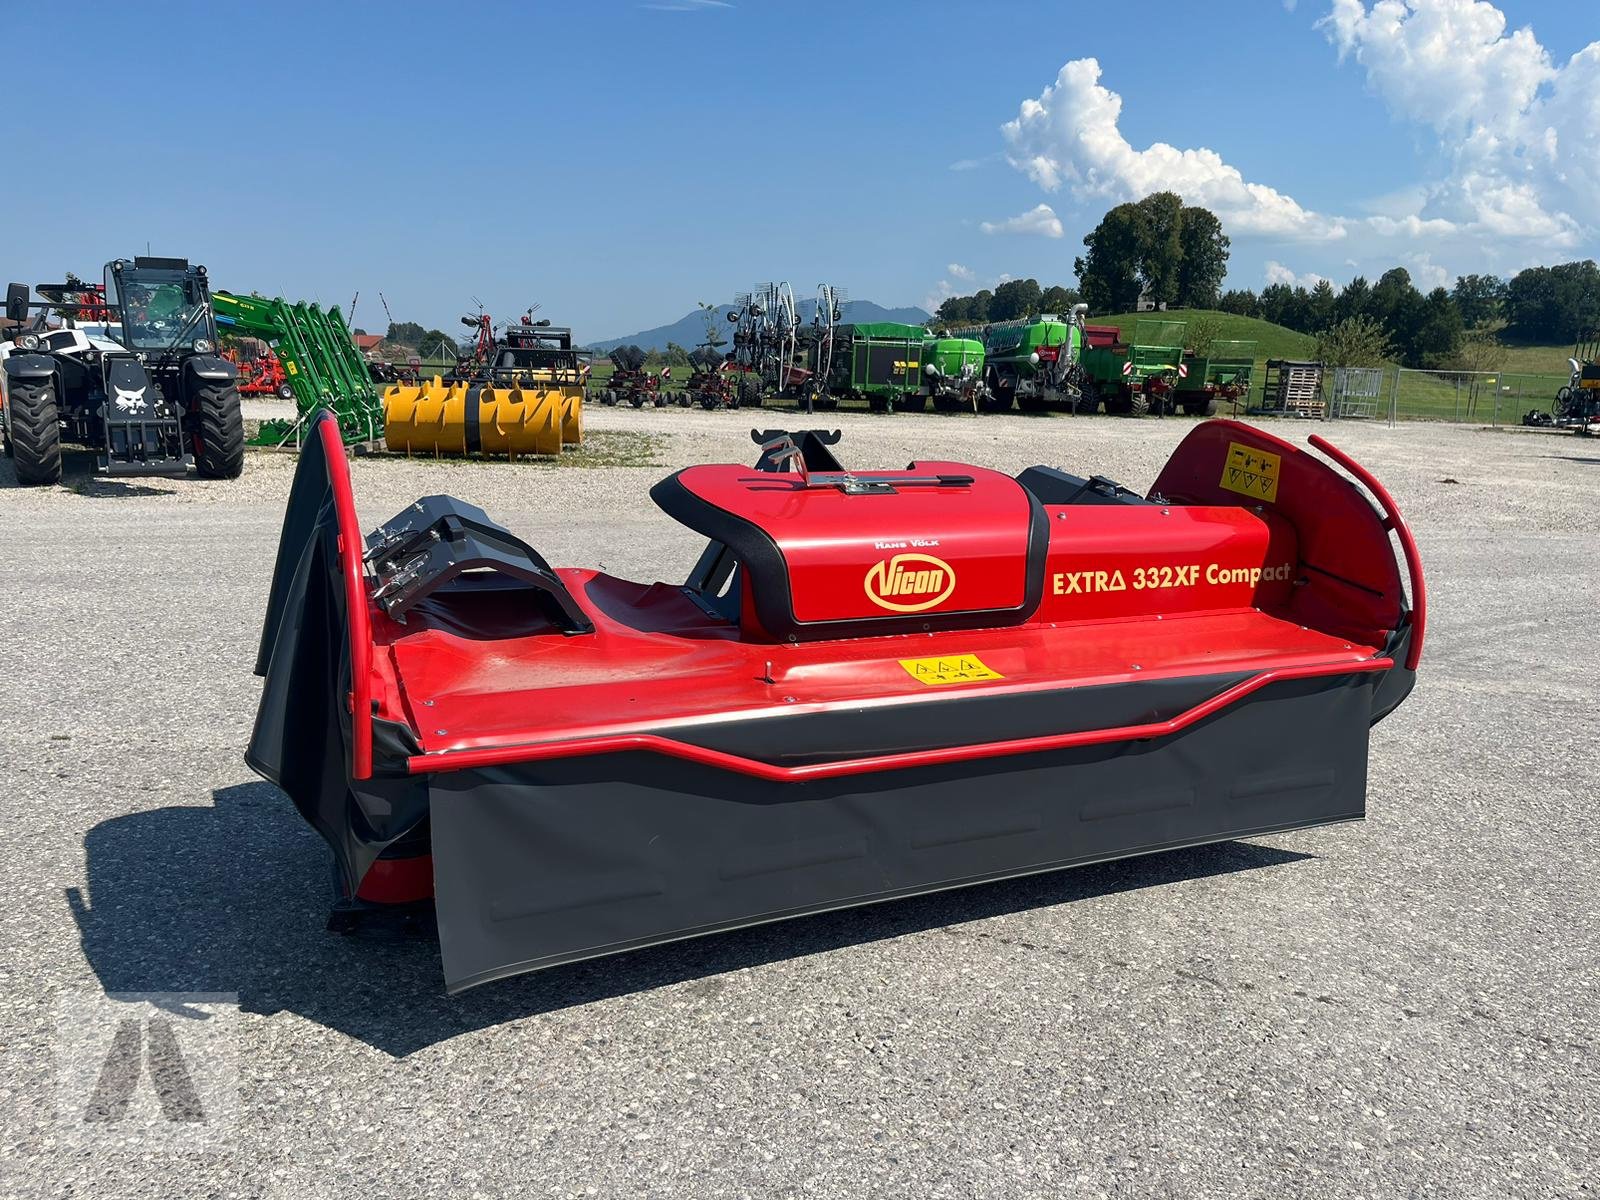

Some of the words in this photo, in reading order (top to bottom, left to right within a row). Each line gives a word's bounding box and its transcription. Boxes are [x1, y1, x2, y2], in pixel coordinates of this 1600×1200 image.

[879, 558, 944, 597] Vicon
[1132, 564, 1200, 591] 332XF
[1205, 562, 1290, 588] Compact
